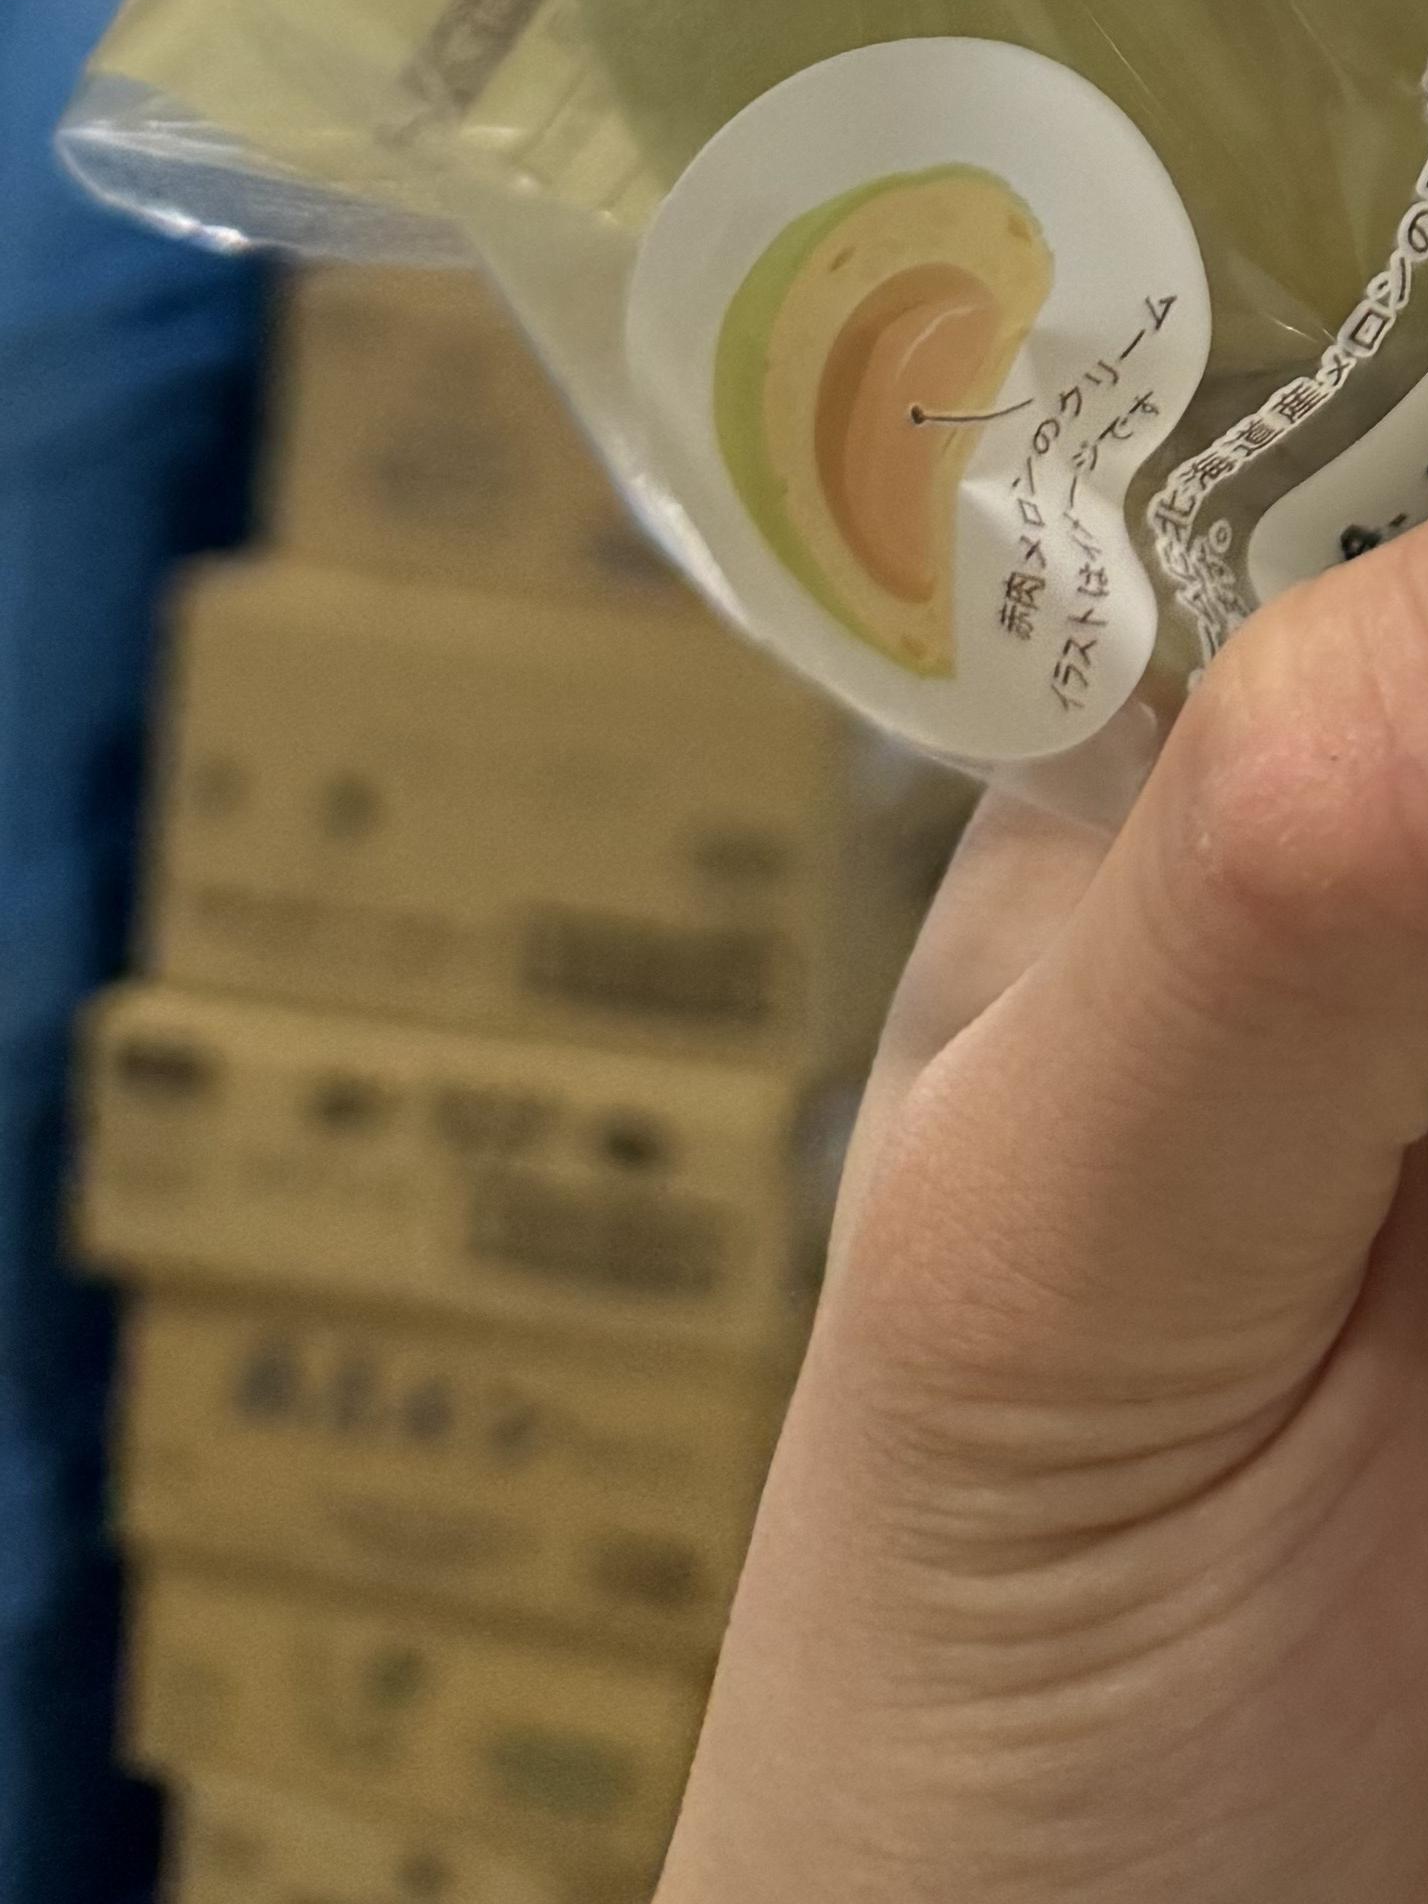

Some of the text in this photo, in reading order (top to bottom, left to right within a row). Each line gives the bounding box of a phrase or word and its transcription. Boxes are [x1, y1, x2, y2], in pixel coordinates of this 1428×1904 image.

[1000, 295, 1178, 640] 赤肉メロンのクリーム
